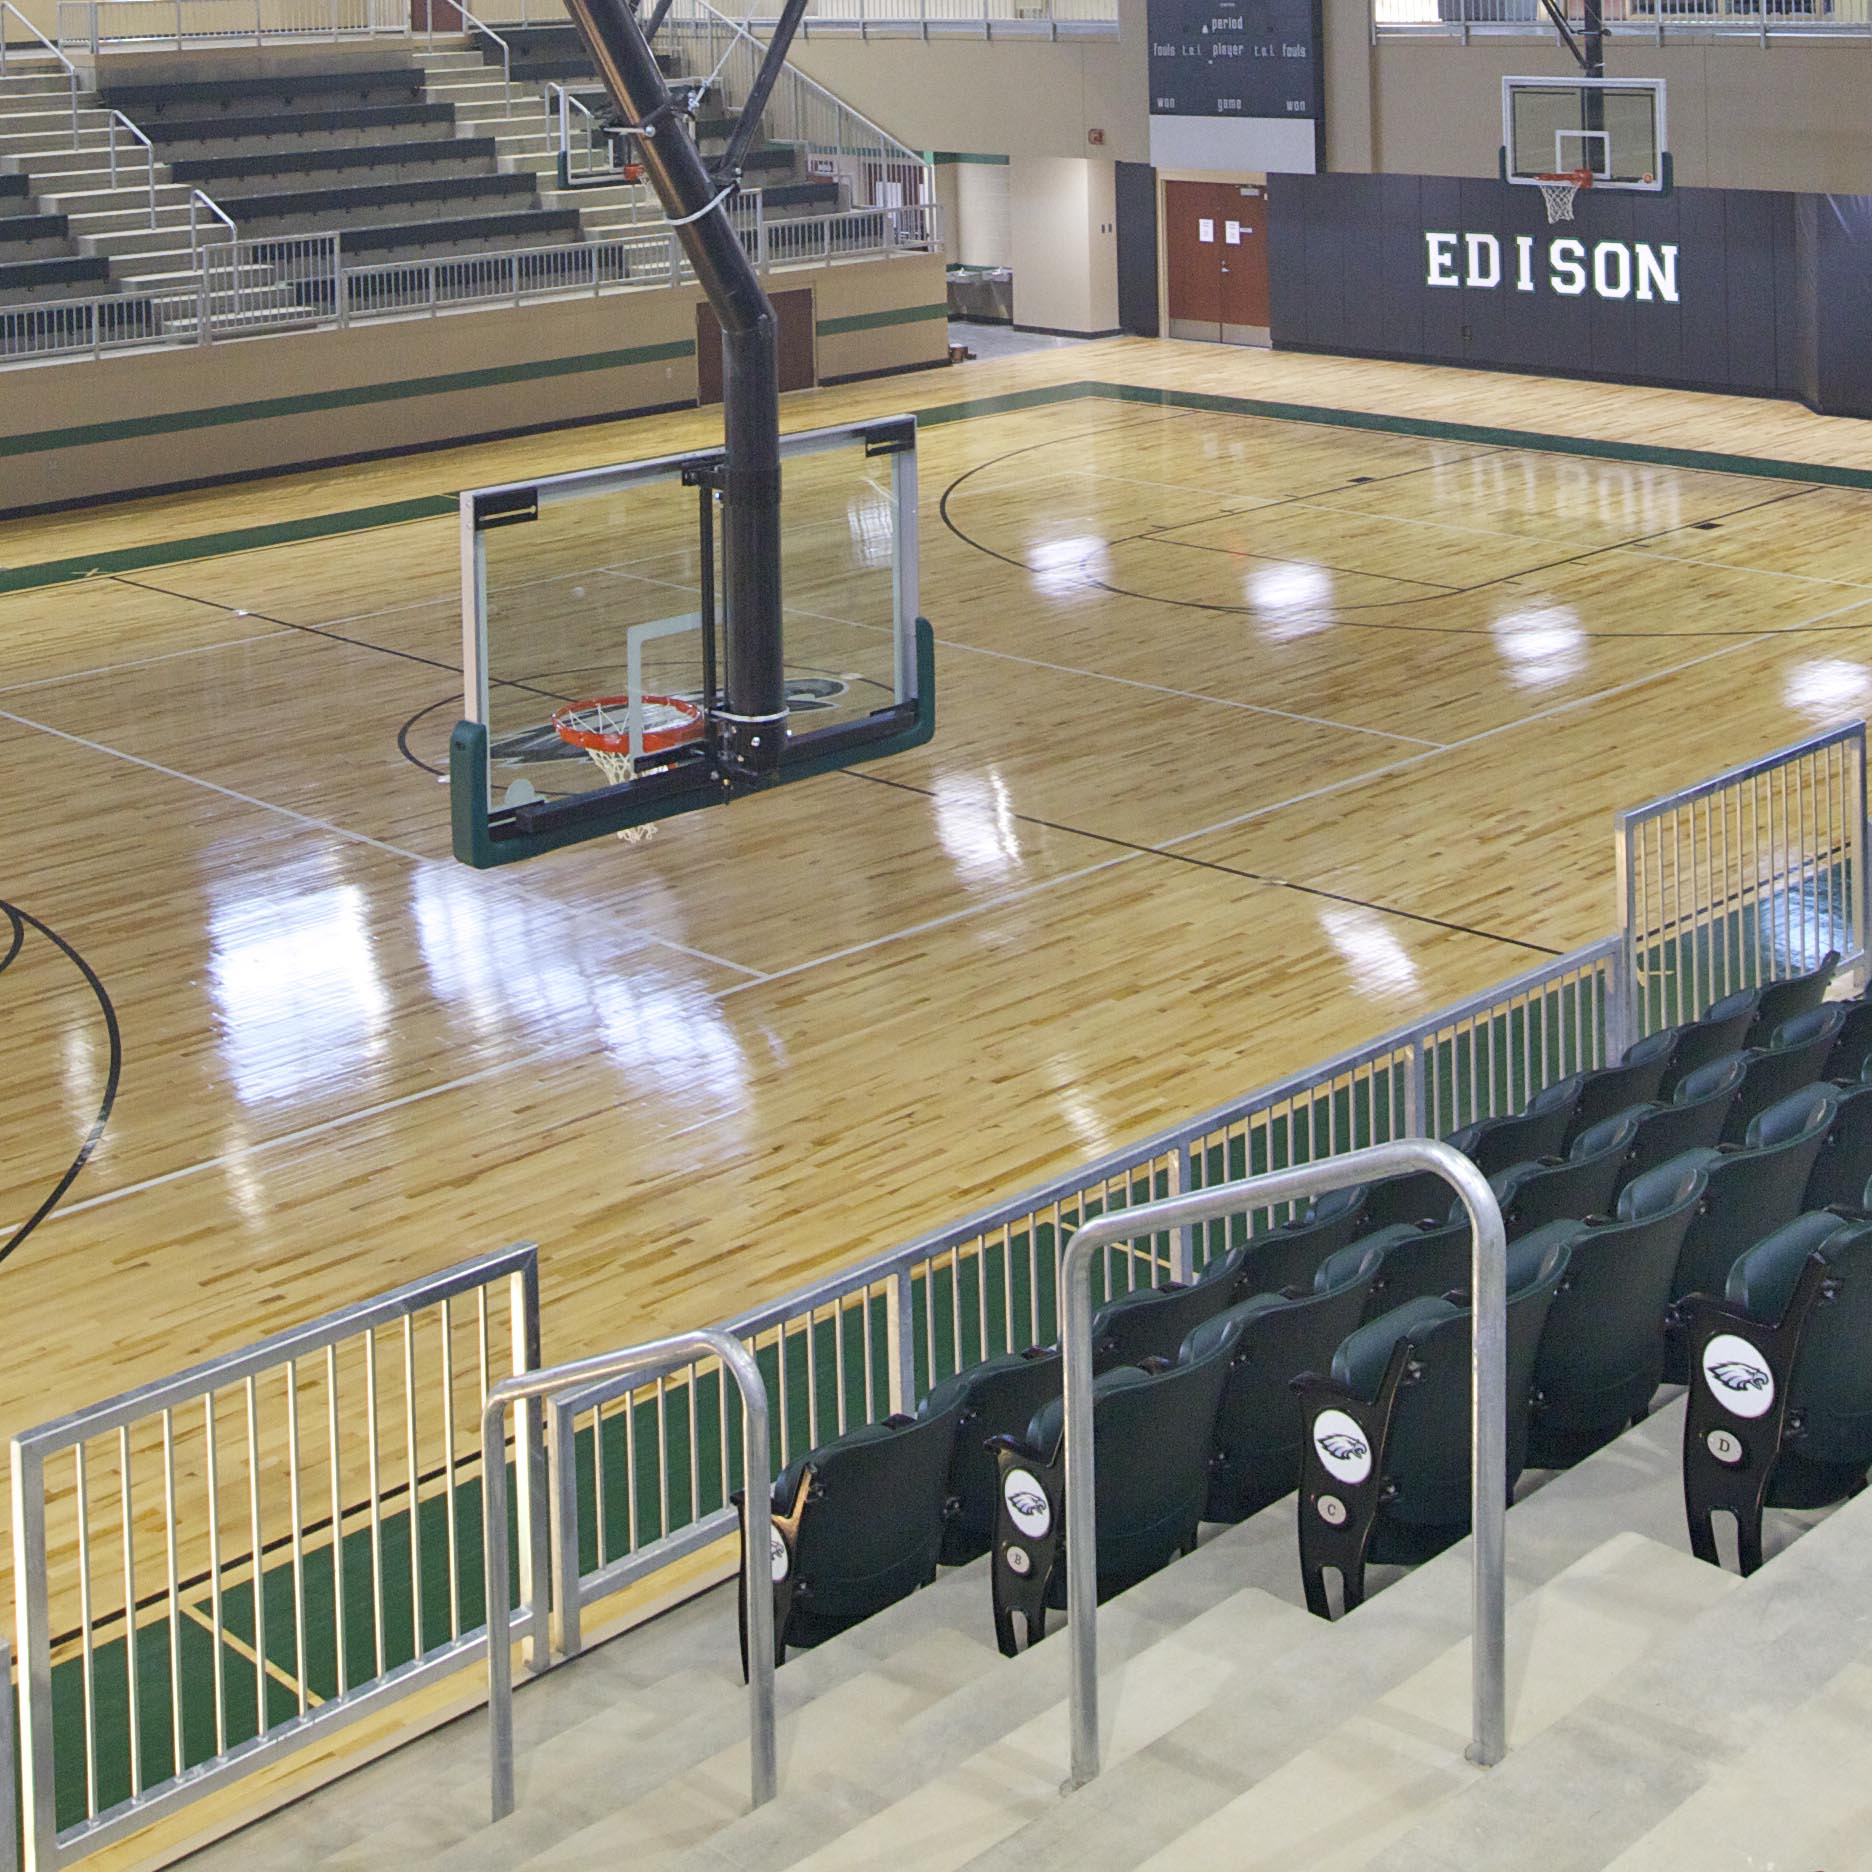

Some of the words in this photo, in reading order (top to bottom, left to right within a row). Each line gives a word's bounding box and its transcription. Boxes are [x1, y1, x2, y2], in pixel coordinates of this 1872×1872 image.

[1211, 16, 1243, 33] period
[1153, 43, 1176, 57] fouls
[1212, 42, 1244, 58] player
[1282, 43, 1306, 58] fouls
[1217, 98, 1242, 112] game
[1425, 230, 1681, 304] EDISON
[1718, 1438, 1731, 1452] D
[1327, 1503, 1336, 1516] C
